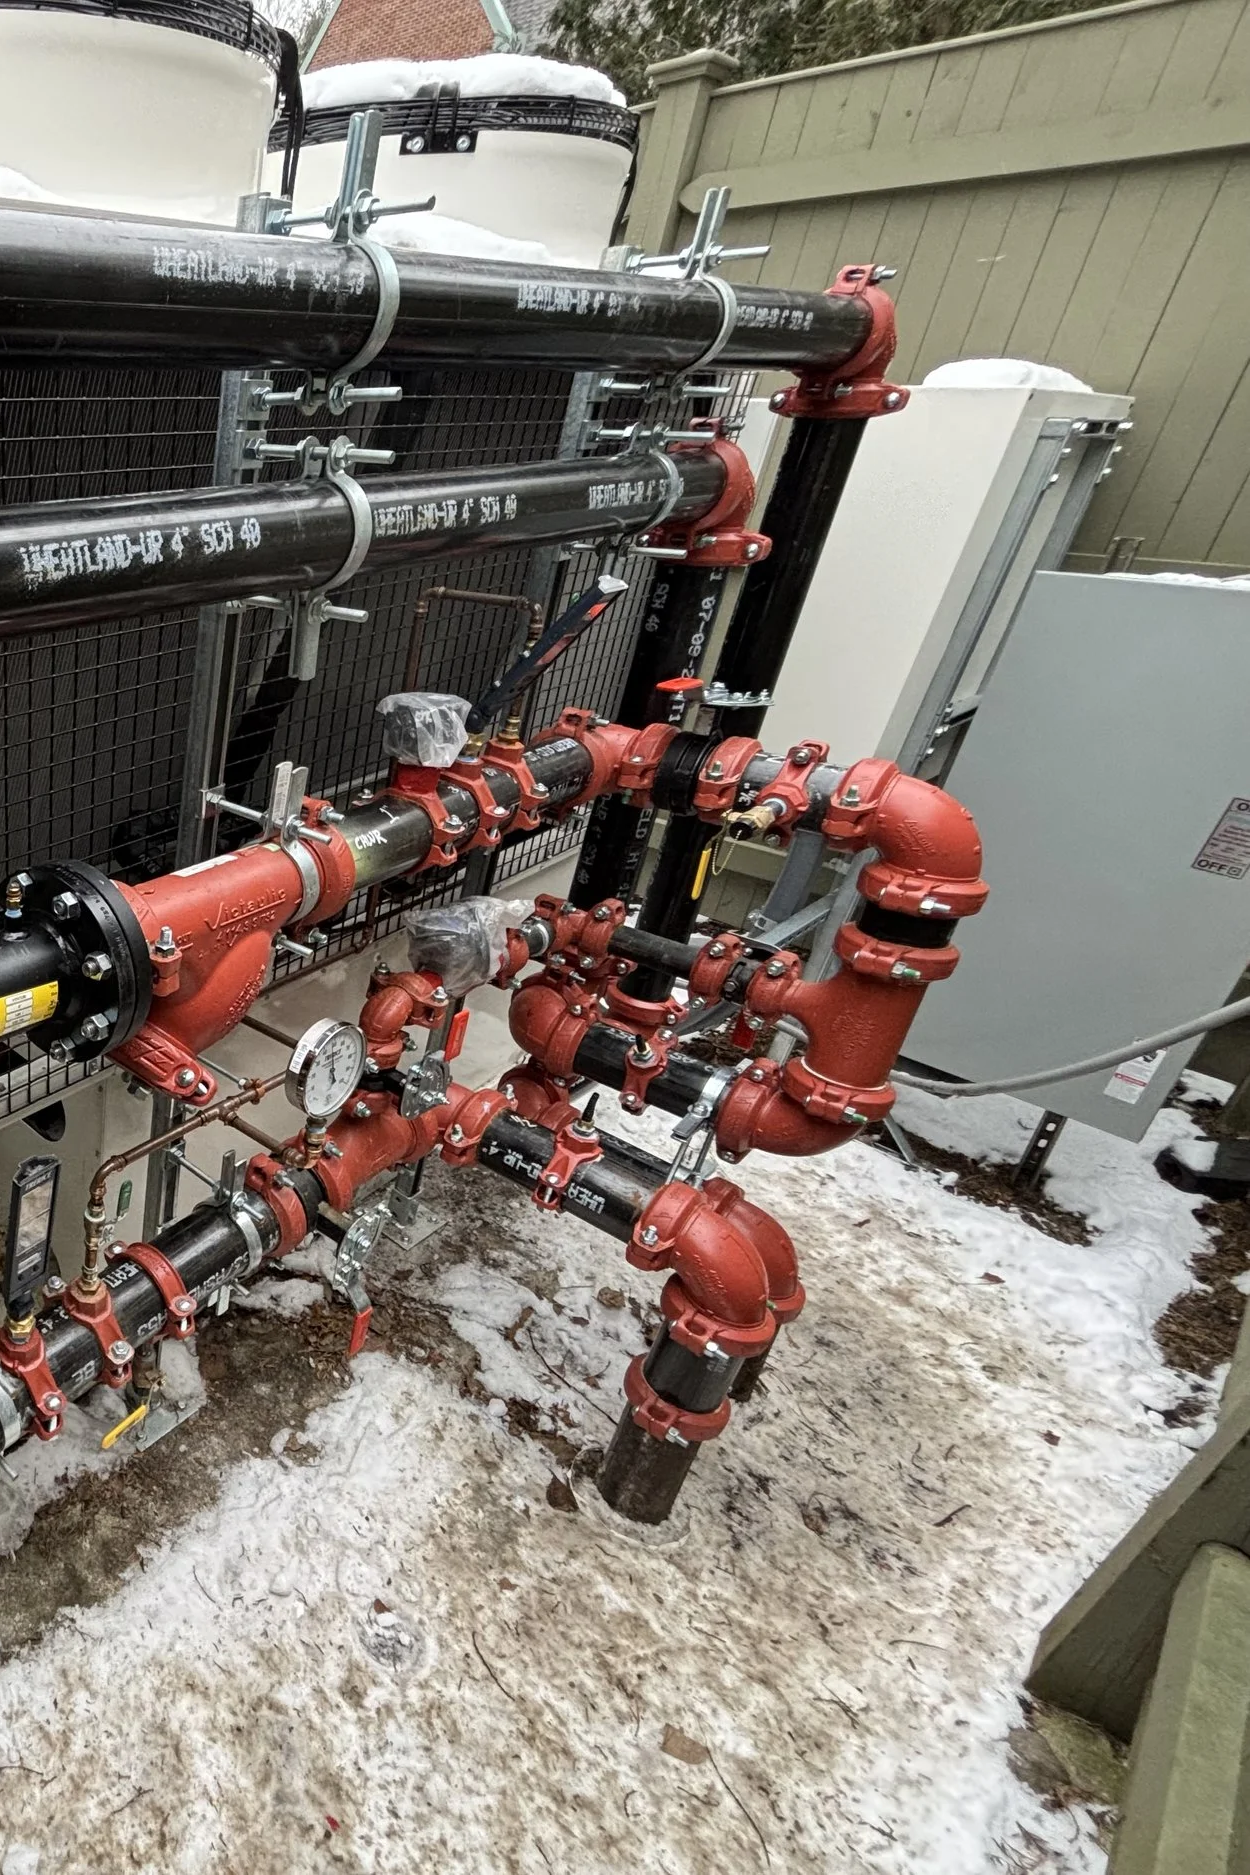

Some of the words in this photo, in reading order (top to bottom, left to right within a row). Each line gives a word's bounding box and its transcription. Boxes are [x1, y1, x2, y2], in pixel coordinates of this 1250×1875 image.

[200, 519, 234, 555] SCH
[240, 517, 261, 550] 40
[1197, 859, 1227, 872] OFF
[204, 887, 287, 931] Victaulic
